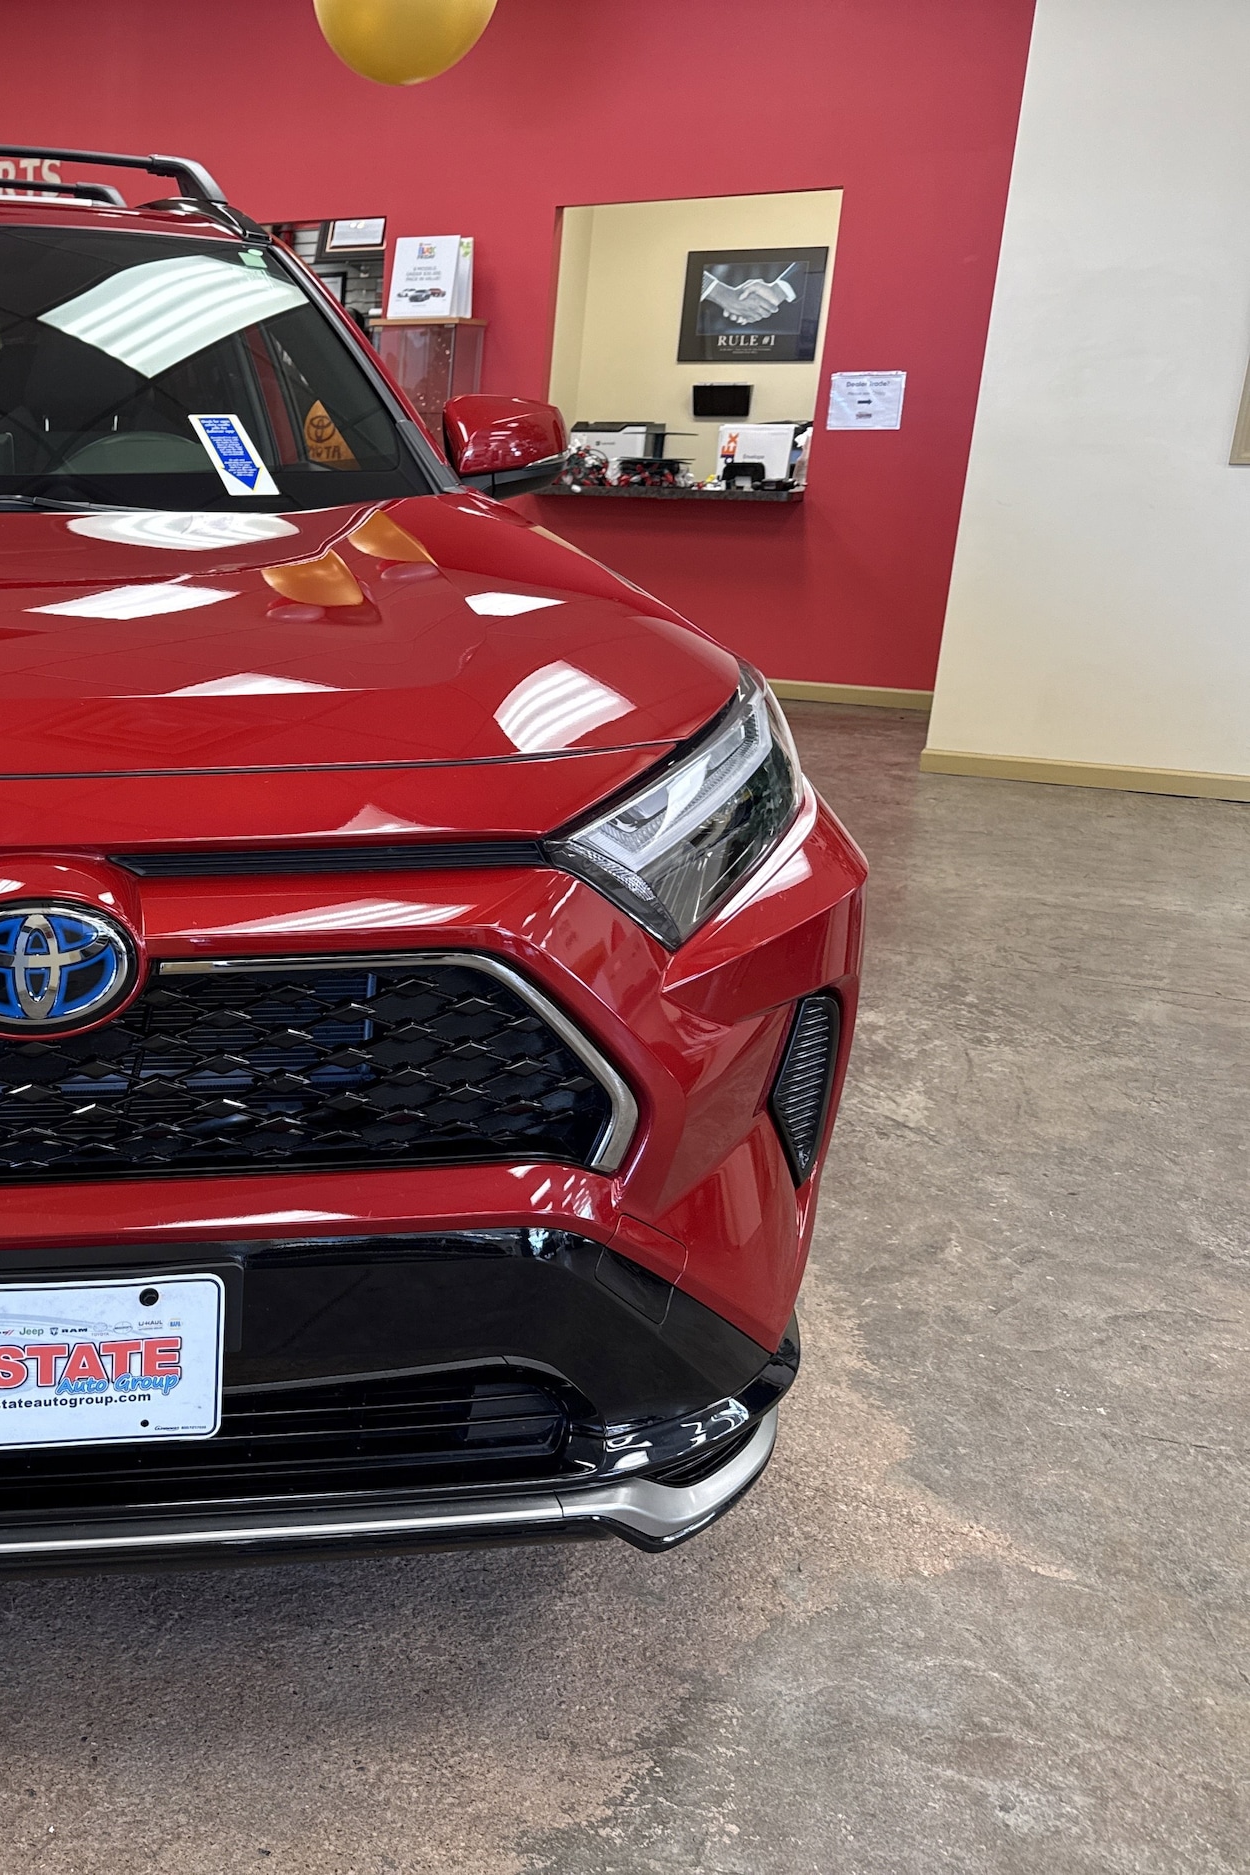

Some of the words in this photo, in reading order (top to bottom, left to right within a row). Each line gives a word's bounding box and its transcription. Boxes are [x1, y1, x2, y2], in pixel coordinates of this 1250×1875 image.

[717, 334, 759, 346] RULE
[761, 334, 775, 346] #1
[19, 1327, 44, 1337] Jeep
[56, 1375, 110, 1395] Auto
[114, 1373, 180, 1395] Group
